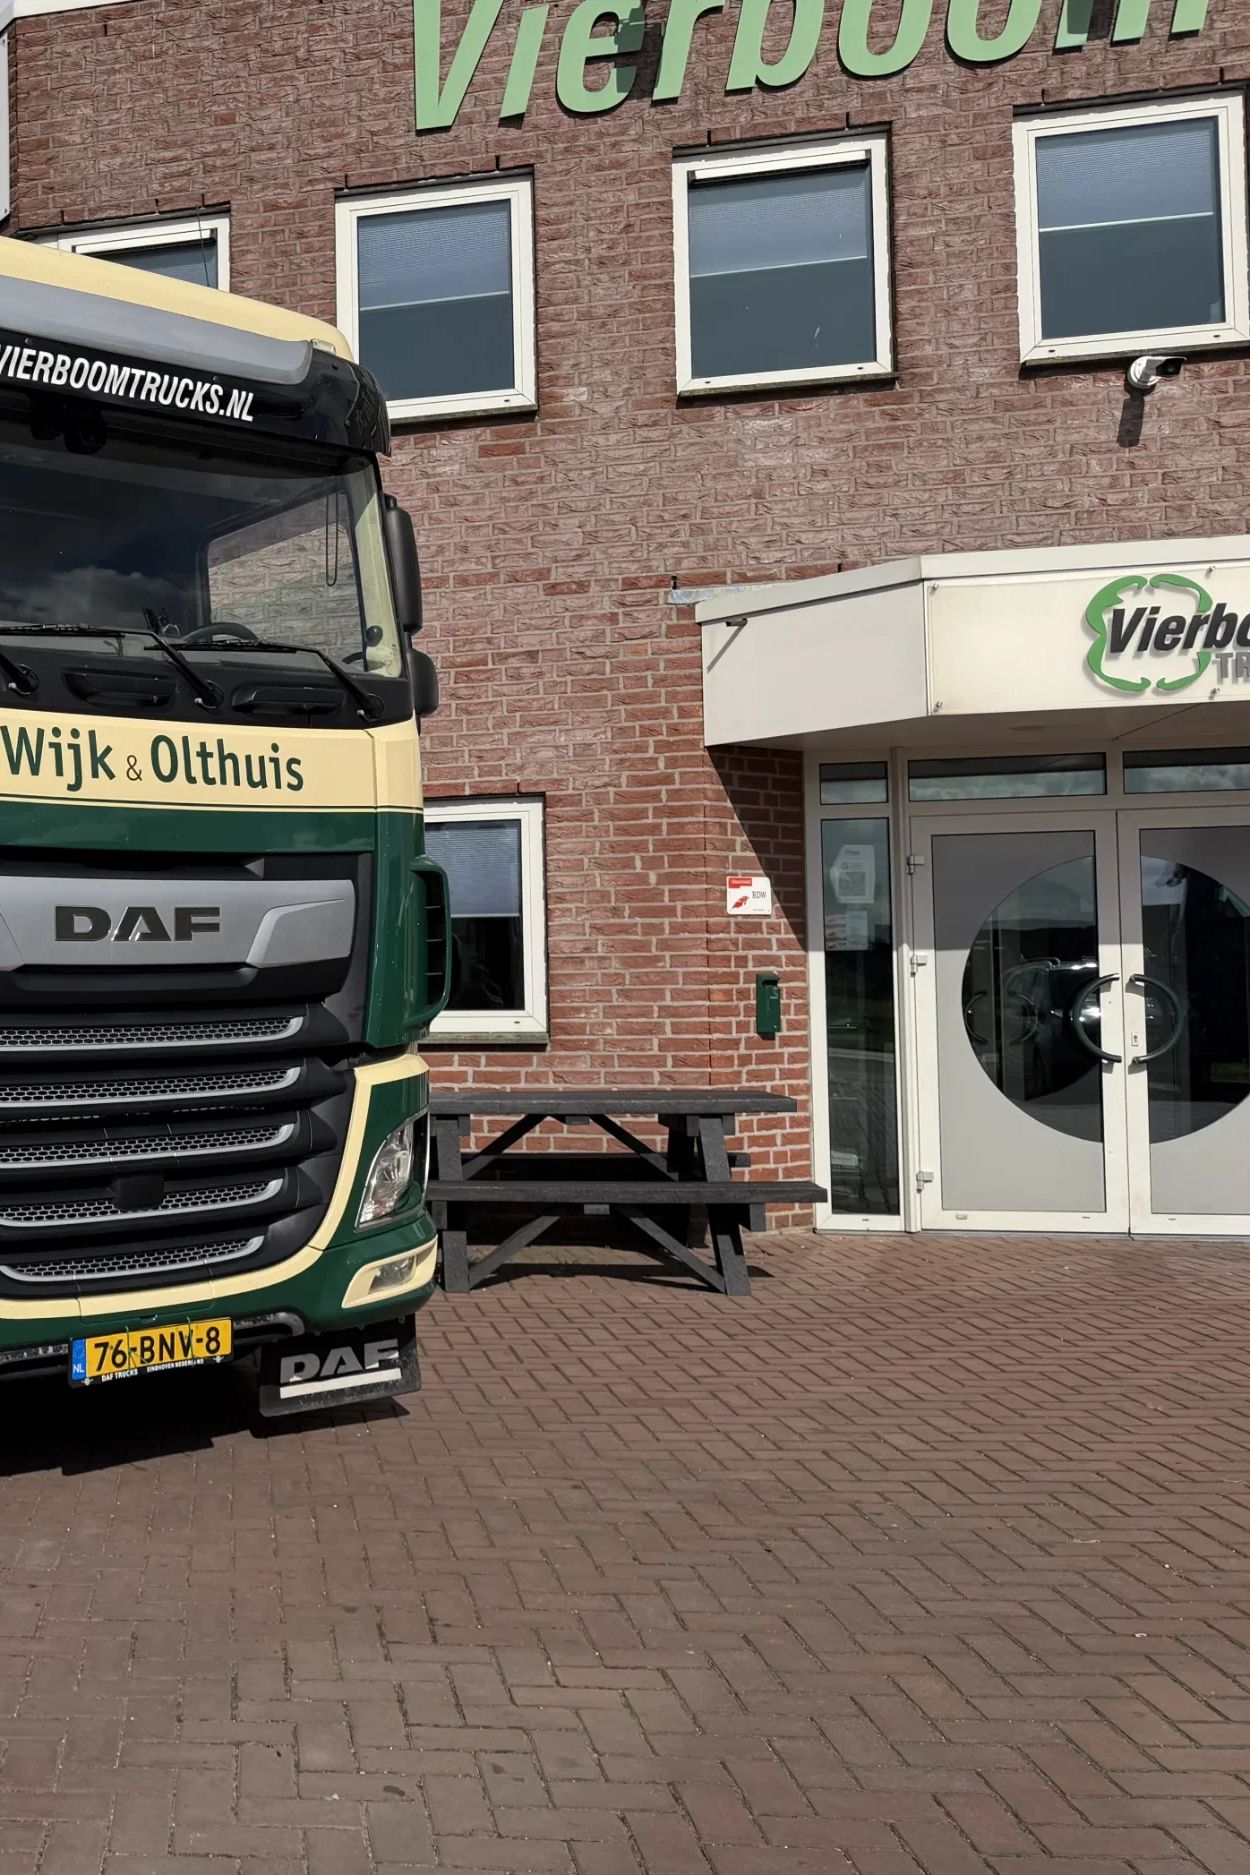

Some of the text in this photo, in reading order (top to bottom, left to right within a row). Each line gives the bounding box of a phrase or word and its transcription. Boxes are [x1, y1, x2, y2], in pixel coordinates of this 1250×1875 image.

[0, 725, 116, 793] Wijk
[125, 754, 143, 781] &
[150, 733, 305, 792] Olthuis
[54, 905, 221, 942] DAF
[73, 1364, 85, 1373] NL
[93, 1326, 222, 1372] 76-BNV-8
[280, 1338, 399, 1384] DAF
[101, 1372, 114, 1382] DAF
[114, 1368, 138, 1380] TRUCKS
